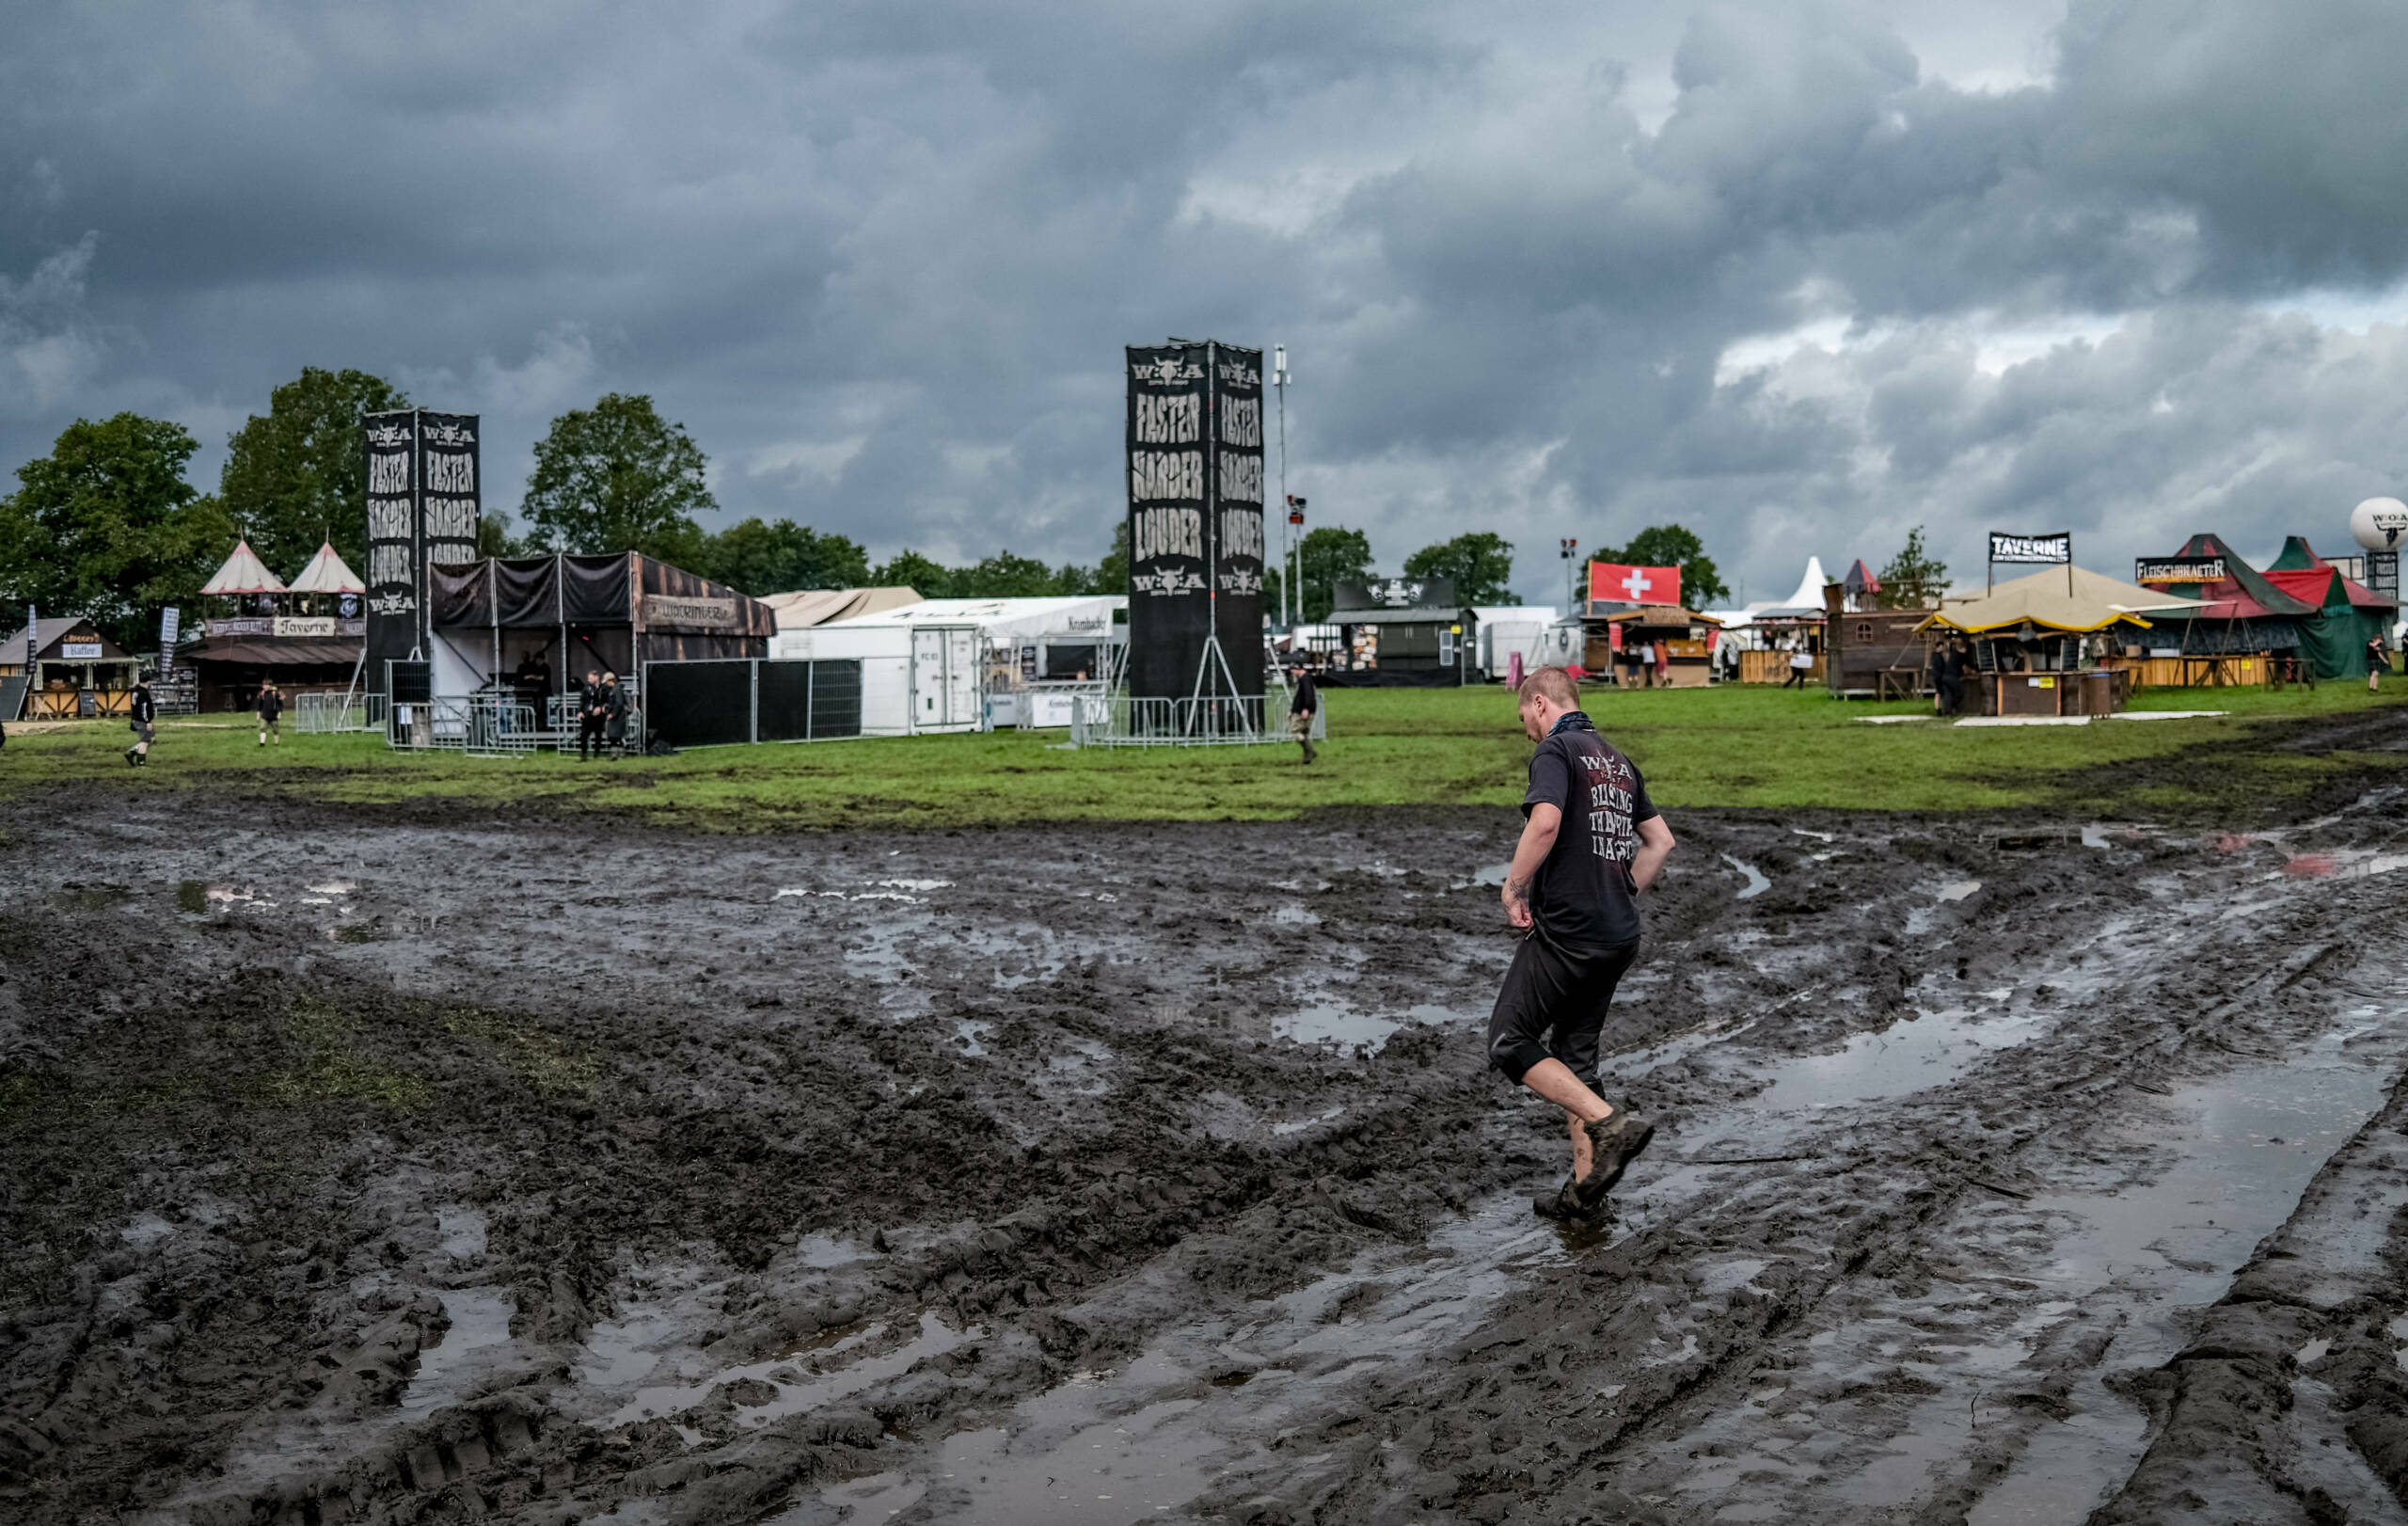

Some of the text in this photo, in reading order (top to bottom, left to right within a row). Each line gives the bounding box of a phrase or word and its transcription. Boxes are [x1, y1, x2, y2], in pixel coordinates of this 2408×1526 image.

[1135, 392, 1201, 443] FASTER
[1221, 393, 1260, 447] FASTER
[369, 451, 409, 494] FASTER
[426, 450, 473, 493] FASTER
[1133, 450, 1203, 502] HARDER
[1220, 451, 1261, 504] HARDER
[367, 498, 411, 541] HARDER
[425, 497, 476, 539] HARDER
[1134, 507, 1203, 562] LOUDER
[1221, 508, 1262, 561] LOUDER
[371, 544, 413, 587] LOUDER
[1991, 536, 2068, 556] TAVERNE
[280, 619, 328, 634] Taverne
